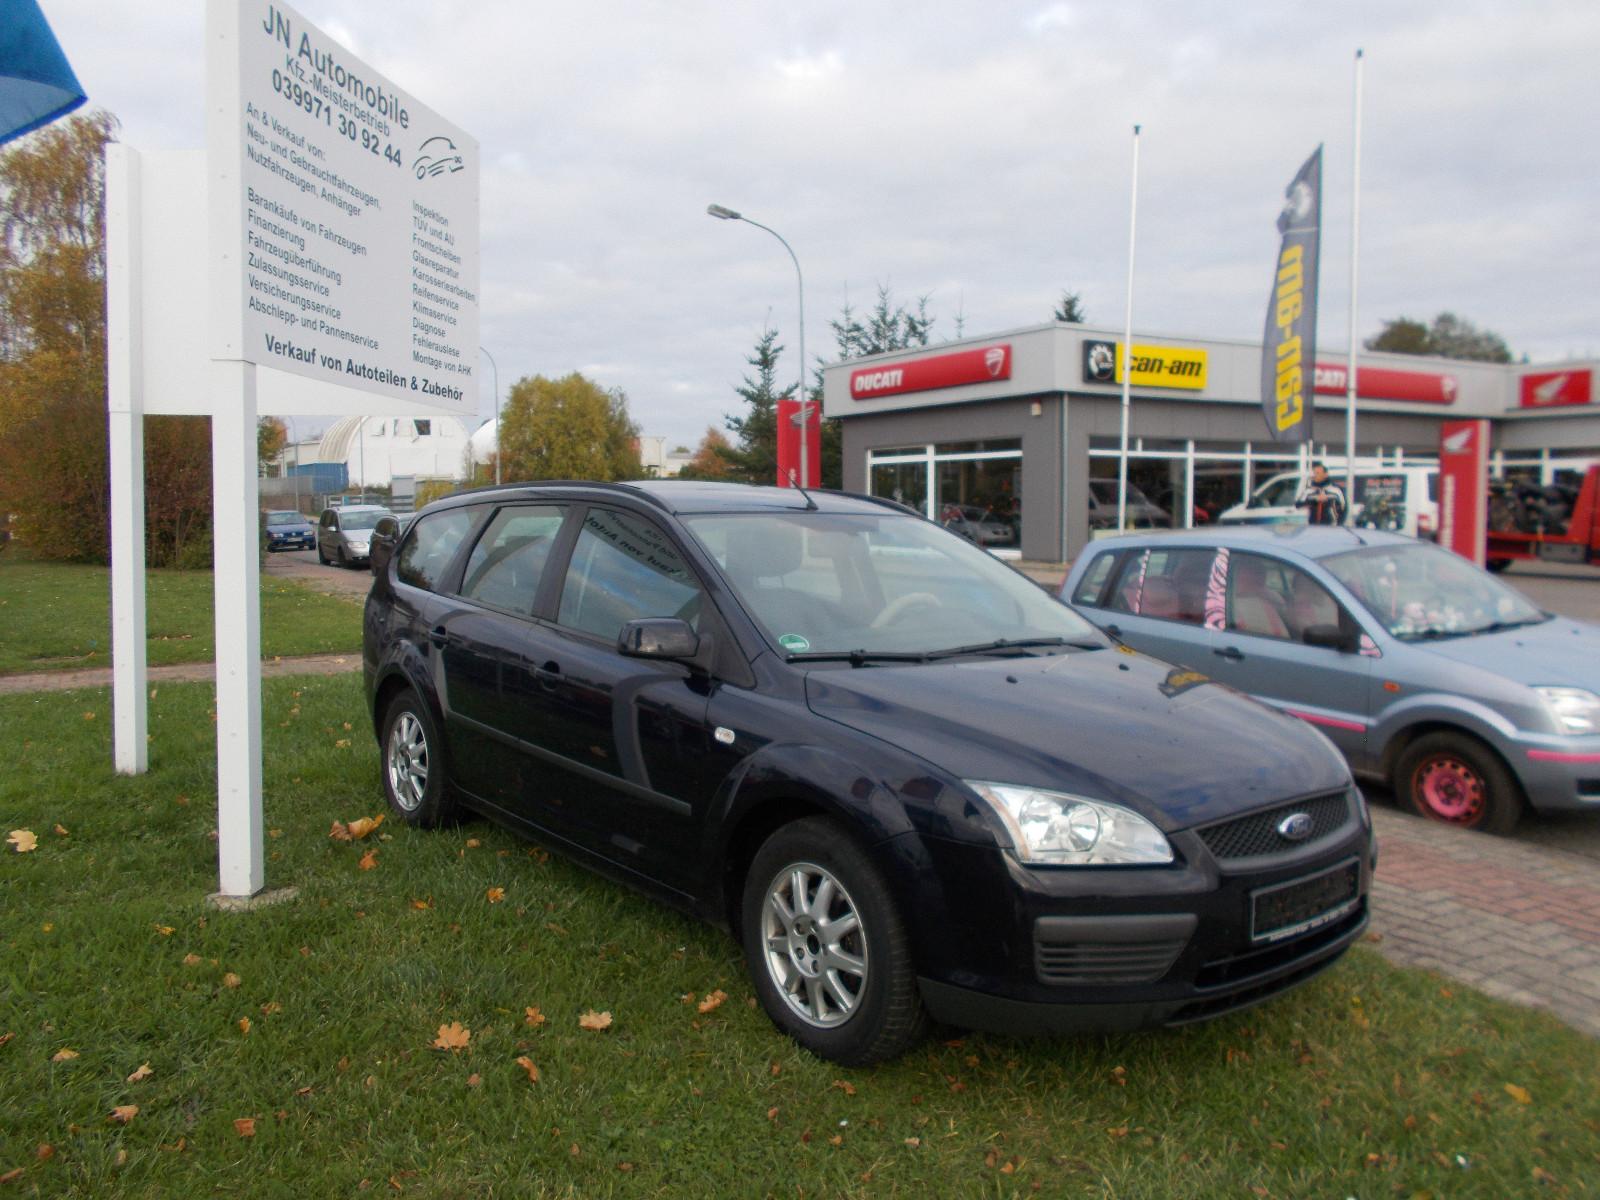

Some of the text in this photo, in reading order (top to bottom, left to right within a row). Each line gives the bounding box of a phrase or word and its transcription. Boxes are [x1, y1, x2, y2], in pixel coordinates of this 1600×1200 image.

[263, 5, 409, 129] JN Automobile
[286, 54, 390, 137] Kfz.-Meisterbetrieb
[246, 101, 326, 161] An & Verkauf von:
[272, 68, 402, 167] 039971 30 92 44
[247, 122, 269, 145] Neu-
[270, 140, 288, 159] und
[247, 144, 361, 216] Nutzfahrzeugen, Anhänger
[248, 186, 367, 256] Barankäufe von Fahrzeugen
[248, 208, 305, 251] Finanzierung
[412, 200, 449, 227] Inspektion
[412, 232, 462, 265] Frontscheiben
[429, 226, 443, 240] und
[444, 232, 455, 247] AU
[248, 230, 342, 286] Fahrzeugüberführung
[248, 251, 330, 297] Zulassungsservice
[412, 249, 460, 279] Glasreparatur
[248, 273, 341, 320] Versicherungsservice
[412, 266, 477, 301] Karosseriearbeiten
[412, 283, 459, 311] Reifenservice
[248, 296, 379, 350] Abschlepp- und Pannenservice
[412, 300, 457, 326] Klimaservice
[412, 317, 446, 337] Diagnose
[412, 333, 460, 358] Fehlerauslese
[412, 350, 472, 376] Montage von AHK
[265, 333, 464, 401] Verkauf von Autoteilen & Zubehör
[854, 369, 904, 392] DUCATI
[1123, 355, 1203, 377] can-am
[1314, 367, 1347, 389] CATI
